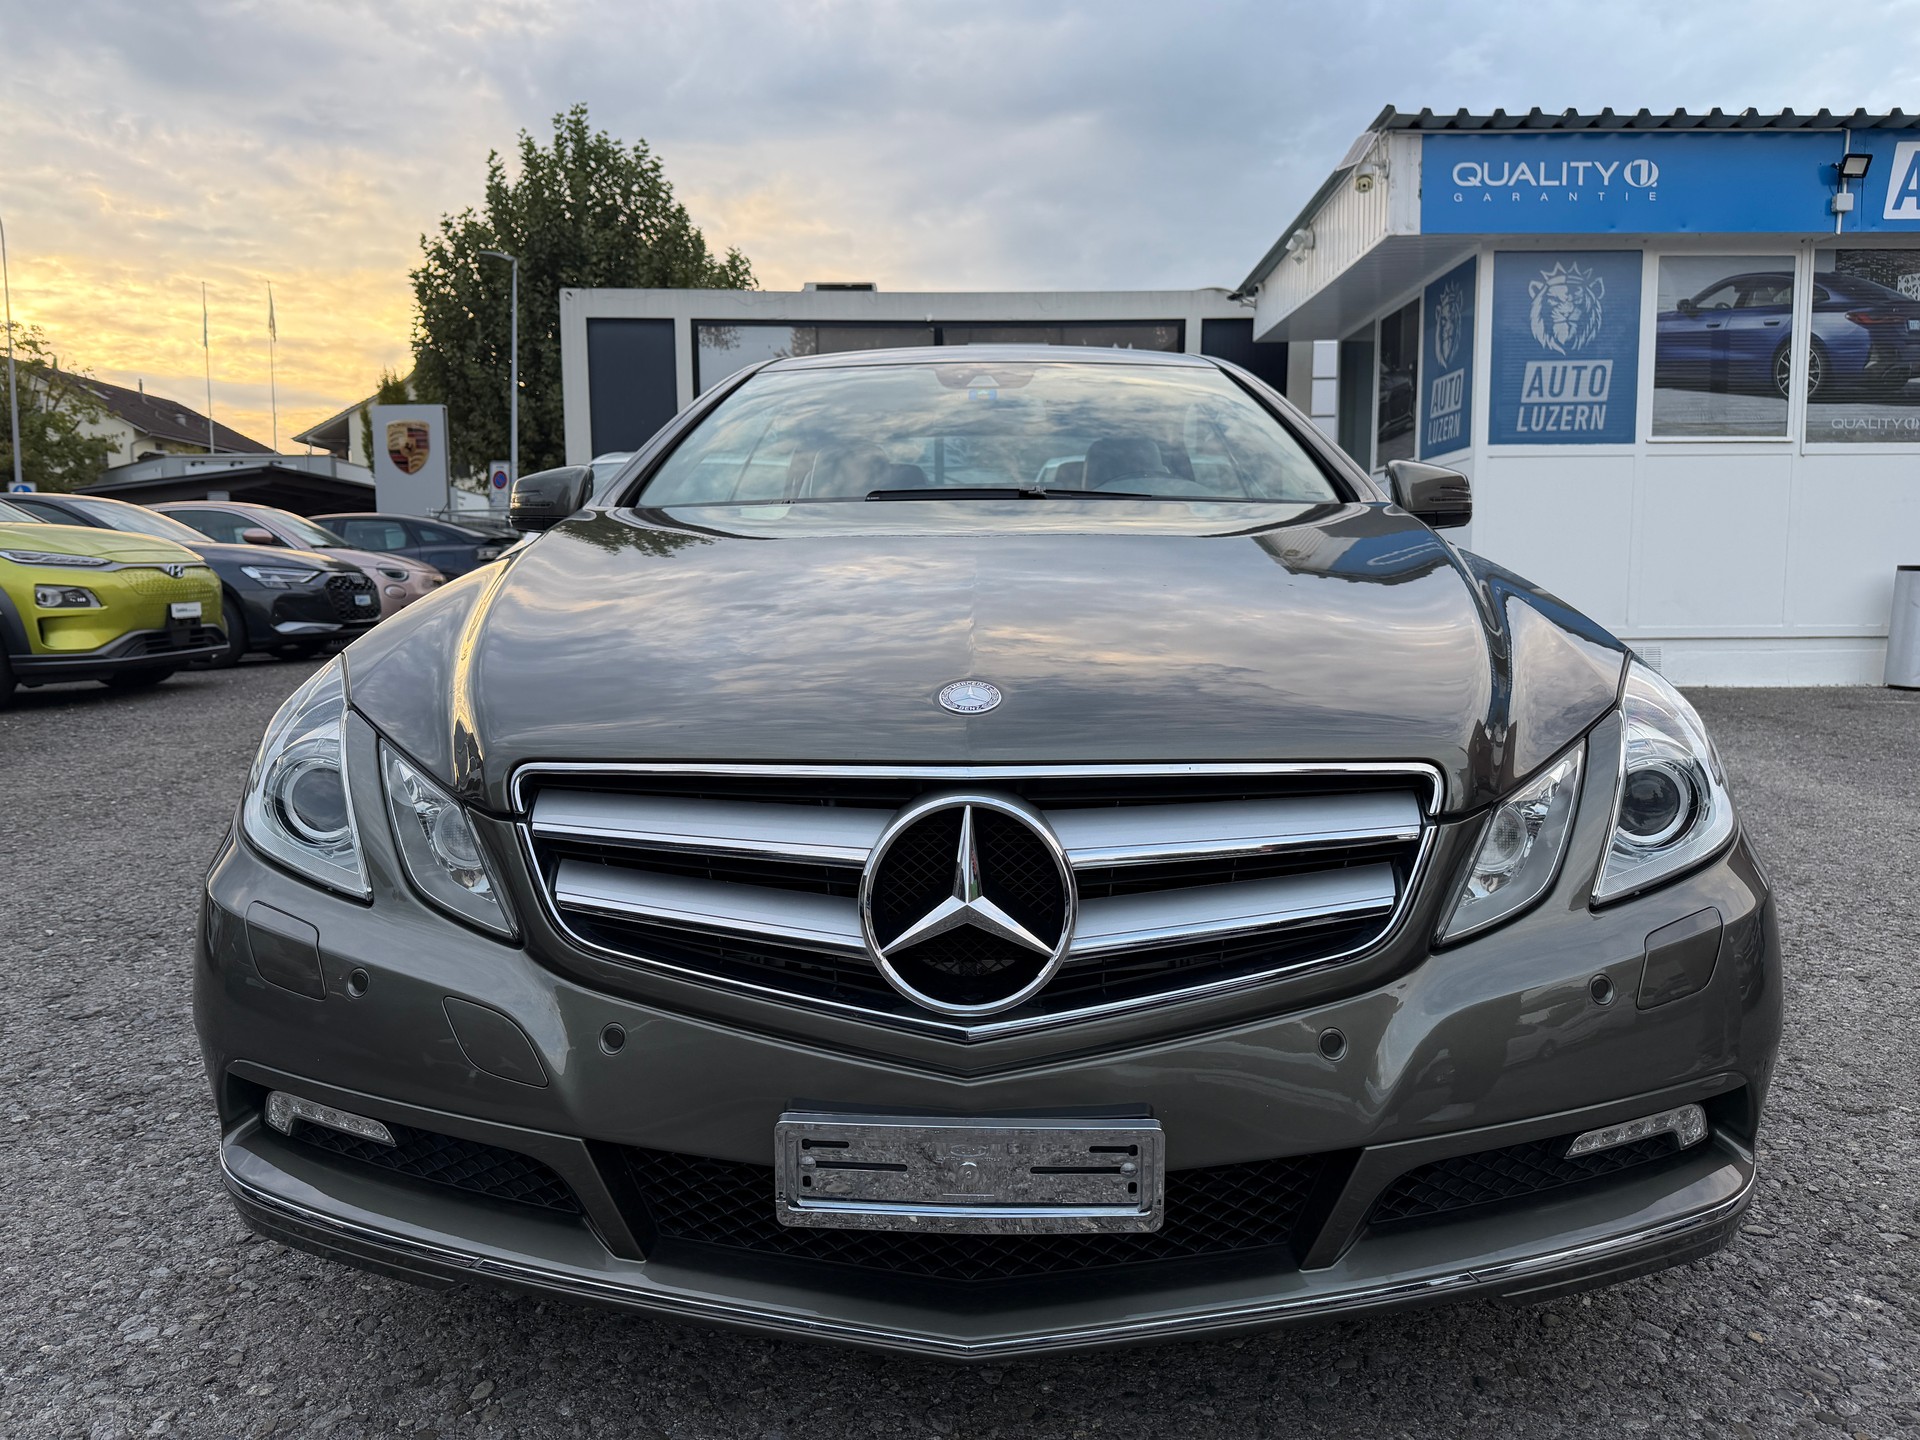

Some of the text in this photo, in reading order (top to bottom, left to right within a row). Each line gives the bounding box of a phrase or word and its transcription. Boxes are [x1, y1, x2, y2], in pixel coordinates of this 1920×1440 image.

[1452, 161, 1620, 187] QUALITY
[1454, 192, 1657, 202] GARANTIE
[1432, 374, 1462, 414] AUTO
[1526, 364, 1608, 399] AUTO
[1427, 412, 1462, 446] LUZERN
[1516, 404, 1607, 432] LUZERN
[1831, 418, 1902, 430] QUALITY
